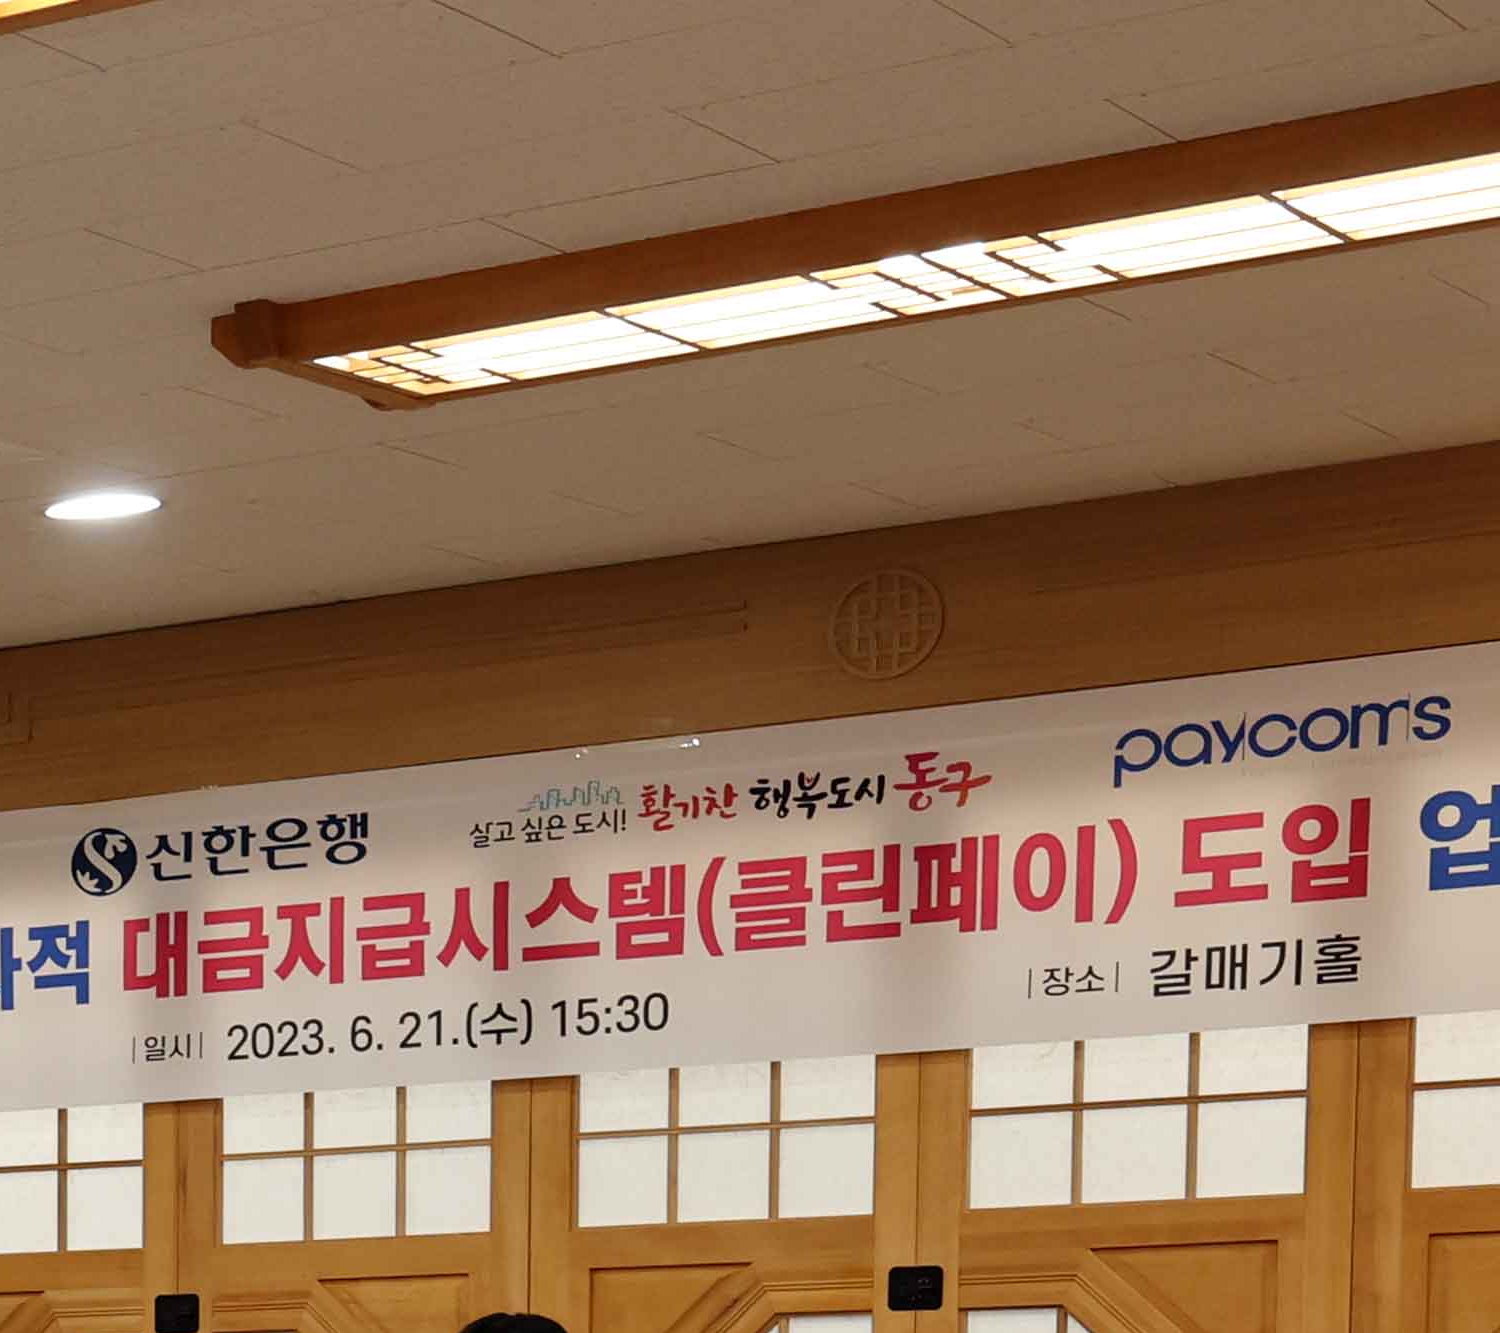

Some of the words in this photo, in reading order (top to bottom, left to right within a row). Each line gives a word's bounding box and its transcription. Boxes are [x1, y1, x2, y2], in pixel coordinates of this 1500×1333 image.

[1113, 696, 1452, 788] paycoms
[637, 783, 739, 832] 활기찬
[748, 771, 886, 820] 행복도시
[892, 751, 993, 812] 동구
[146, 812, 369, 882] 신한은행
[469, 821, 516, 849] 살고
[520, 814, 567, 844] 싶은
[572, 808, 627, 836] 도시!
[1174, 796, 1372, 908] 도입
[1150, 933, 1362, 998] 갈매기홀
[227, 1018, 336, 1062] 2023.
[350, 1015, 384, 1053] 6.
[551, 992, 670, 1037] 15:30
